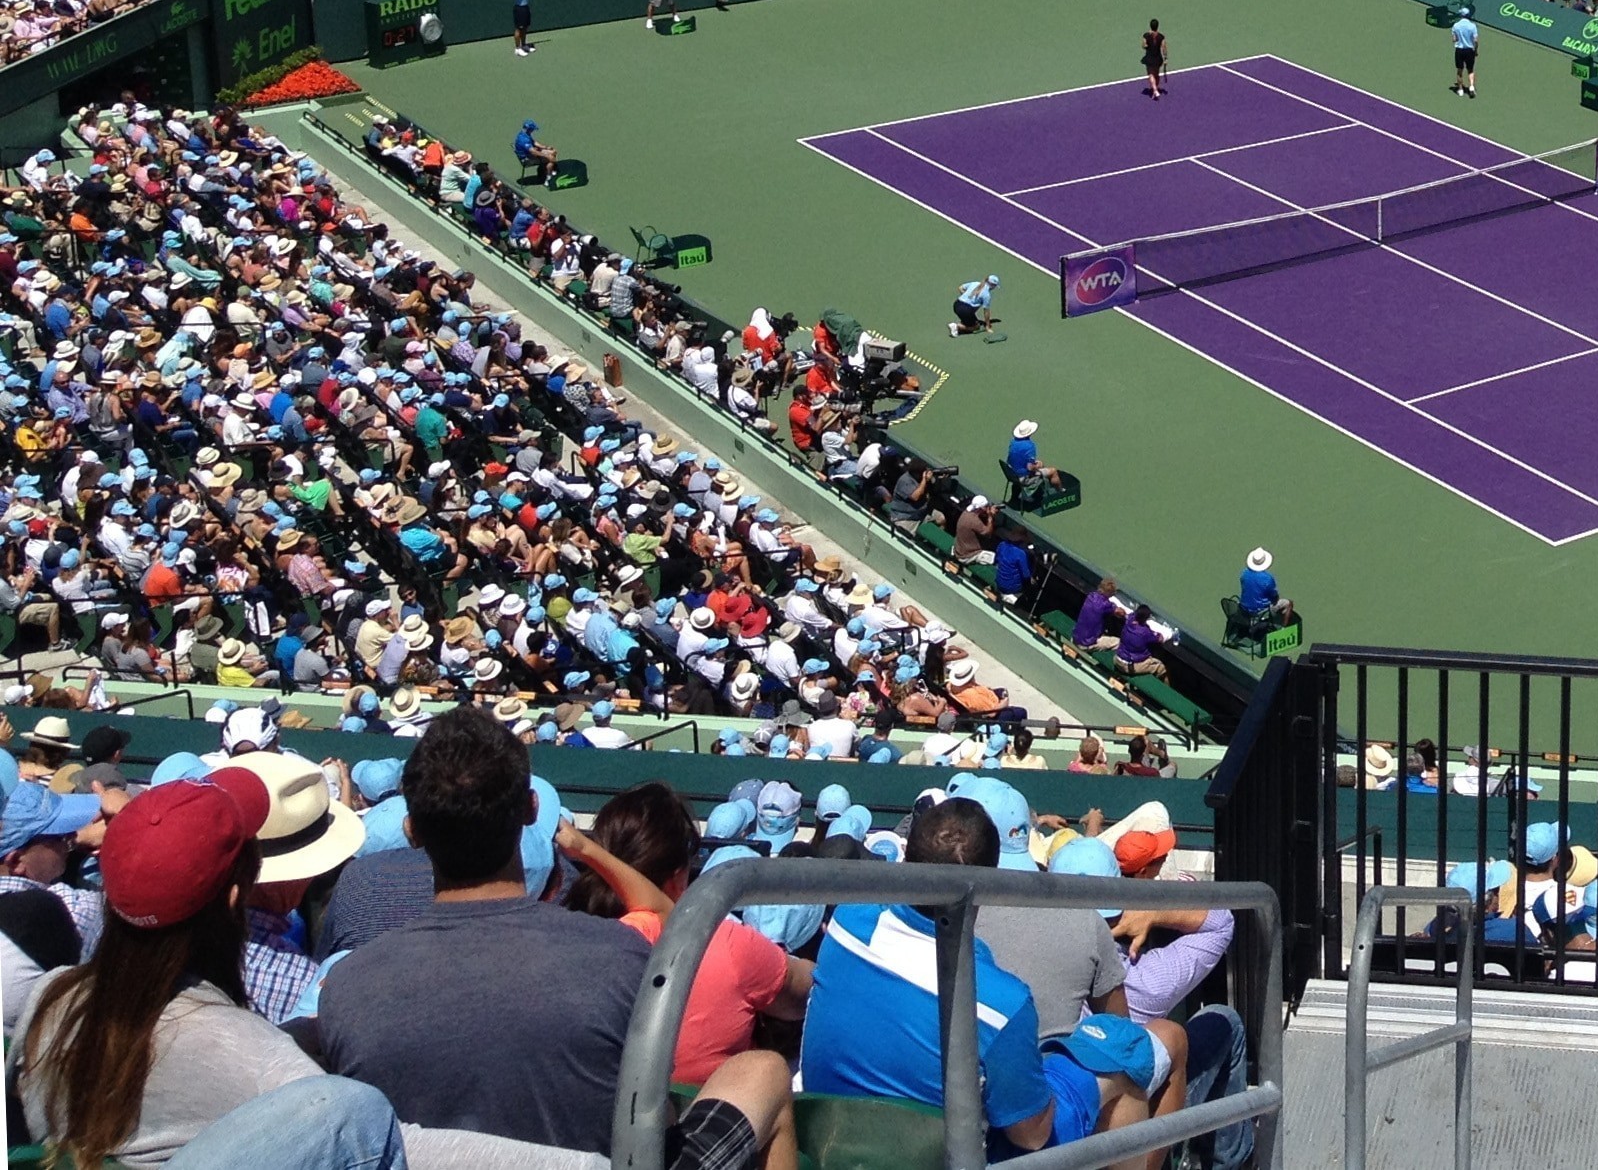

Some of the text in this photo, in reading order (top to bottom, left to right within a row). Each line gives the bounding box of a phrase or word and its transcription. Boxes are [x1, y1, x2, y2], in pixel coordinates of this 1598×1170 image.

[1514, 10, 1554, 28] LEXUS
[259, 14, 296, 62] Enel
[679, 252, 705, 266] Itaú
[1080, 270, 1122, 292] WTA
[1043, 494, 1076, 511] LACOSTE
[1268, 633, 1296, 653] Itaú
